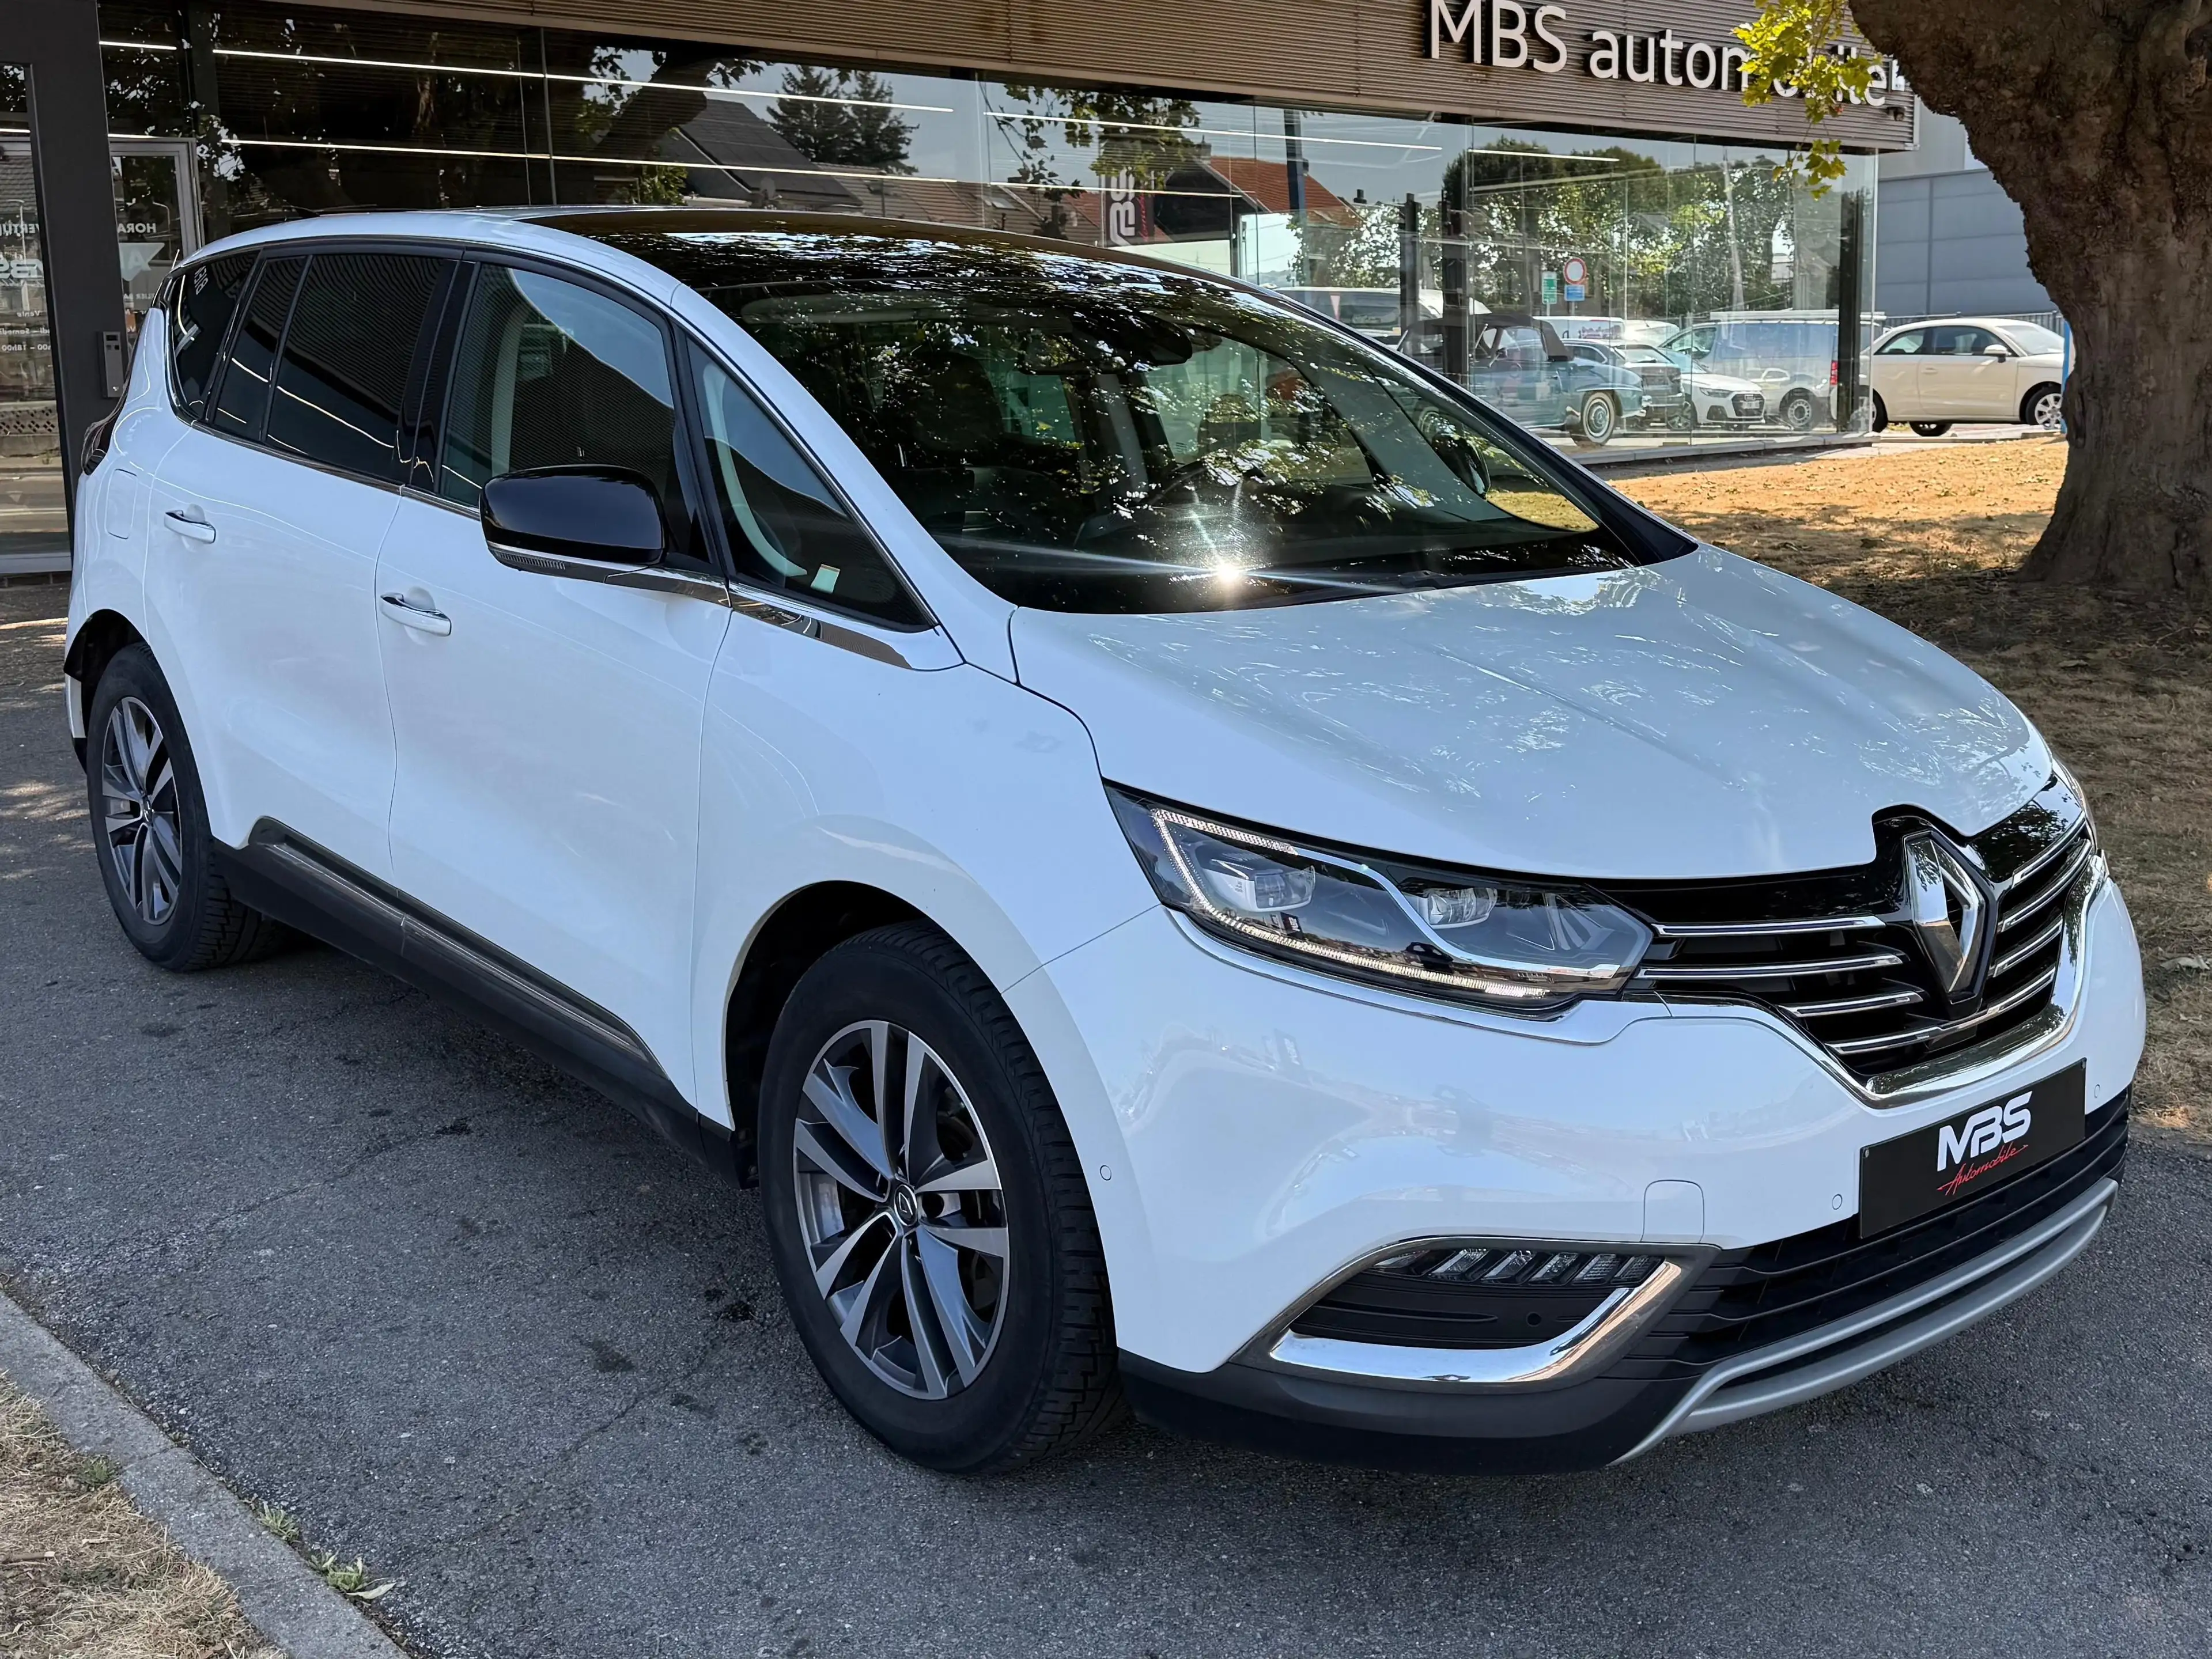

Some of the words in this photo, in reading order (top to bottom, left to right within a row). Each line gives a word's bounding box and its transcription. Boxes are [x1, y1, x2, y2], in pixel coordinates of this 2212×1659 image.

[1431, 0, 1567, 73] MBS
[1937, 1090, 2033, 1172] MBS
[1937, 1141, 2029, 1196] Automobile
